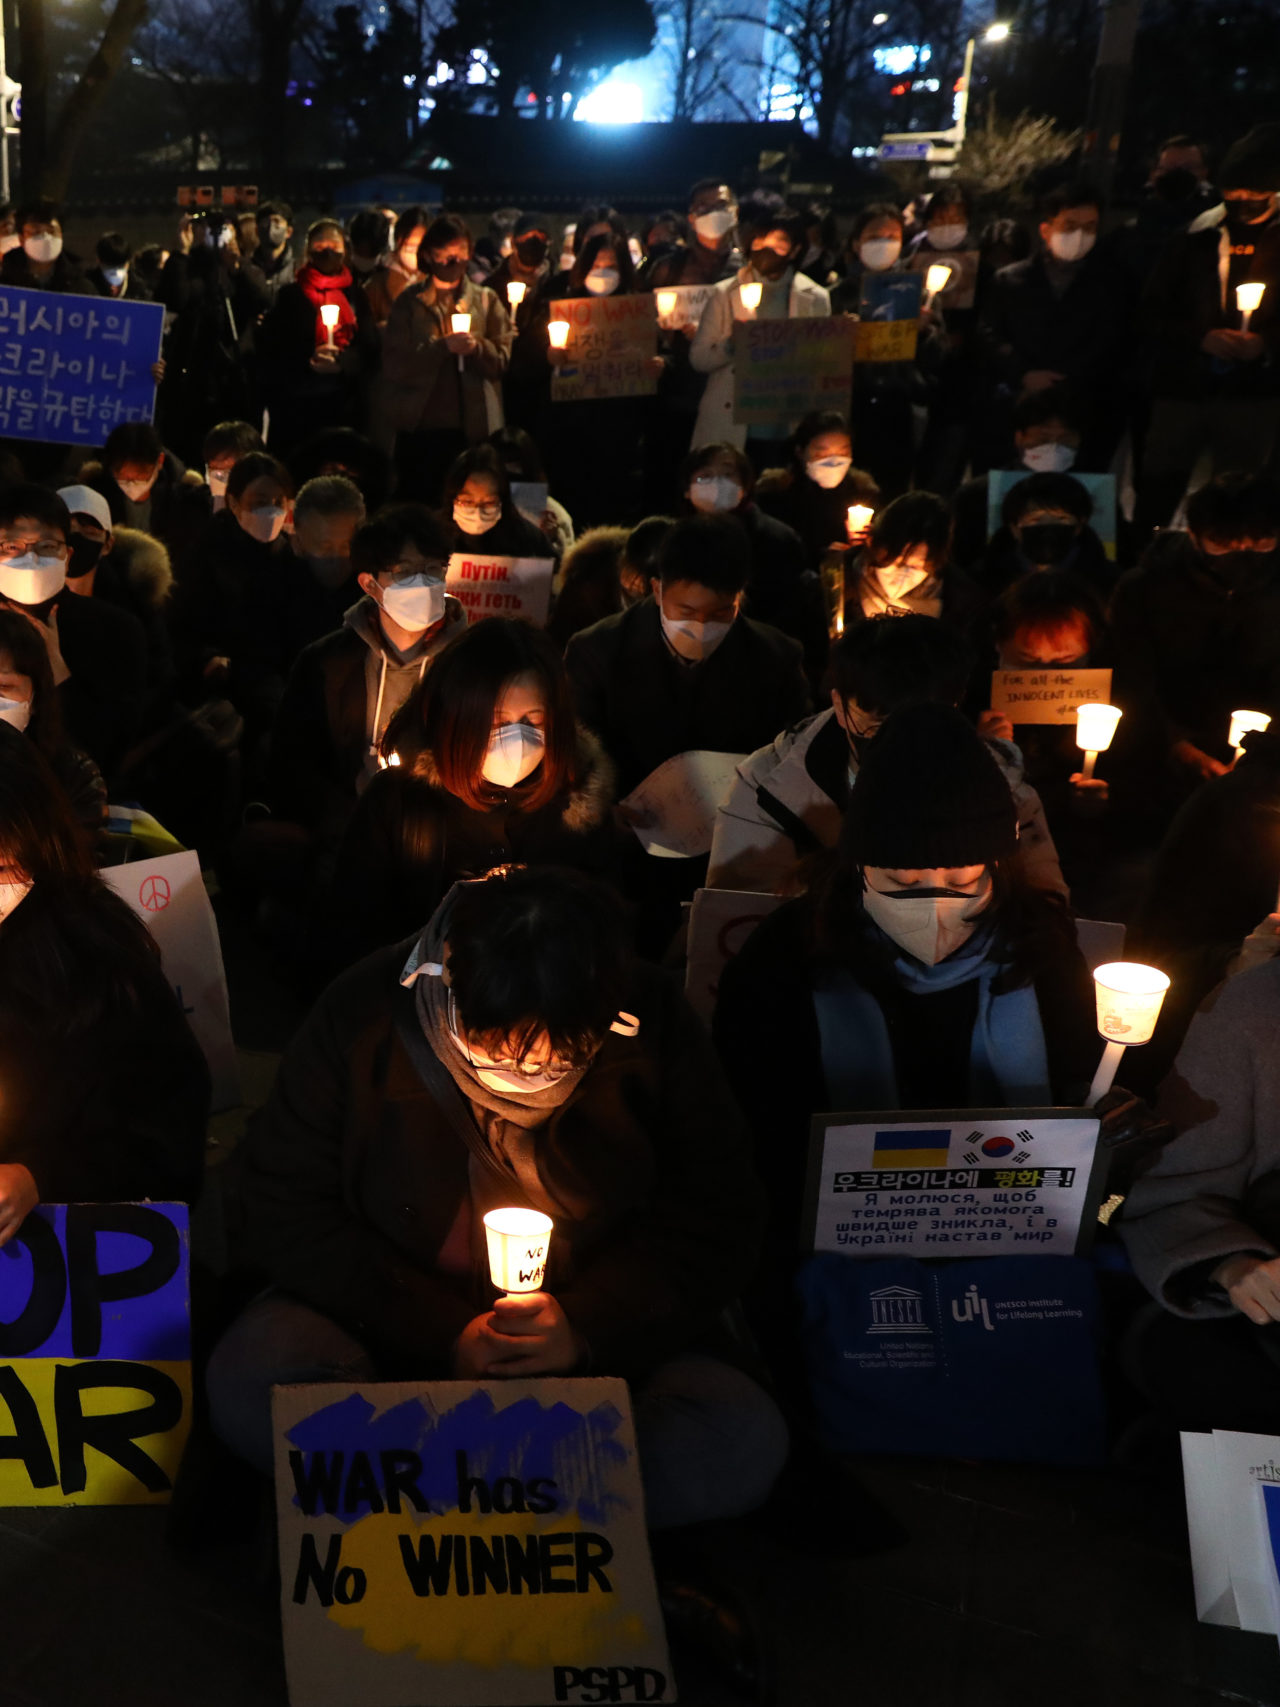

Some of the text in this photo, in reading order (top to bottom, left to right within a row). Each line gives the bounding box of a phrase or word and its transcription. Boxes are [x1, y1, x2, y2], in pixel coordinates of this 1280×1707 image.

[554, 301, 592, 326] NO
[602, 298, 650, 324] WAR
[485, 592, 522, 609] геть
[1030, 674, 1047, 685] all
[1006, 689, 1099, 703] INNOCENT LIVES
[834, 1168, 1073, 1192] 우크라이나에 평화를!
[865, 1190, 1037, 1206] Я молюся, щоб
[851, 1205, 1044, 1219] темрява якомога
[836, 1220, 919, 1234] швидше
[930, 1218, 1014, 1231] зникла,
[1046, 1217, 1058, 1228] в
[836, 1230, 1053, 1247] Україні настав мир
[526, 1247, 543, 1259] NO
[996, 1308, 1083, 1321] for Lifelong Learning
[289, 1449, 558, 1515] WAR has
[293, 1532, 614, 1607] No WINNER
[553, 1666, 666, 1703] PSPD
